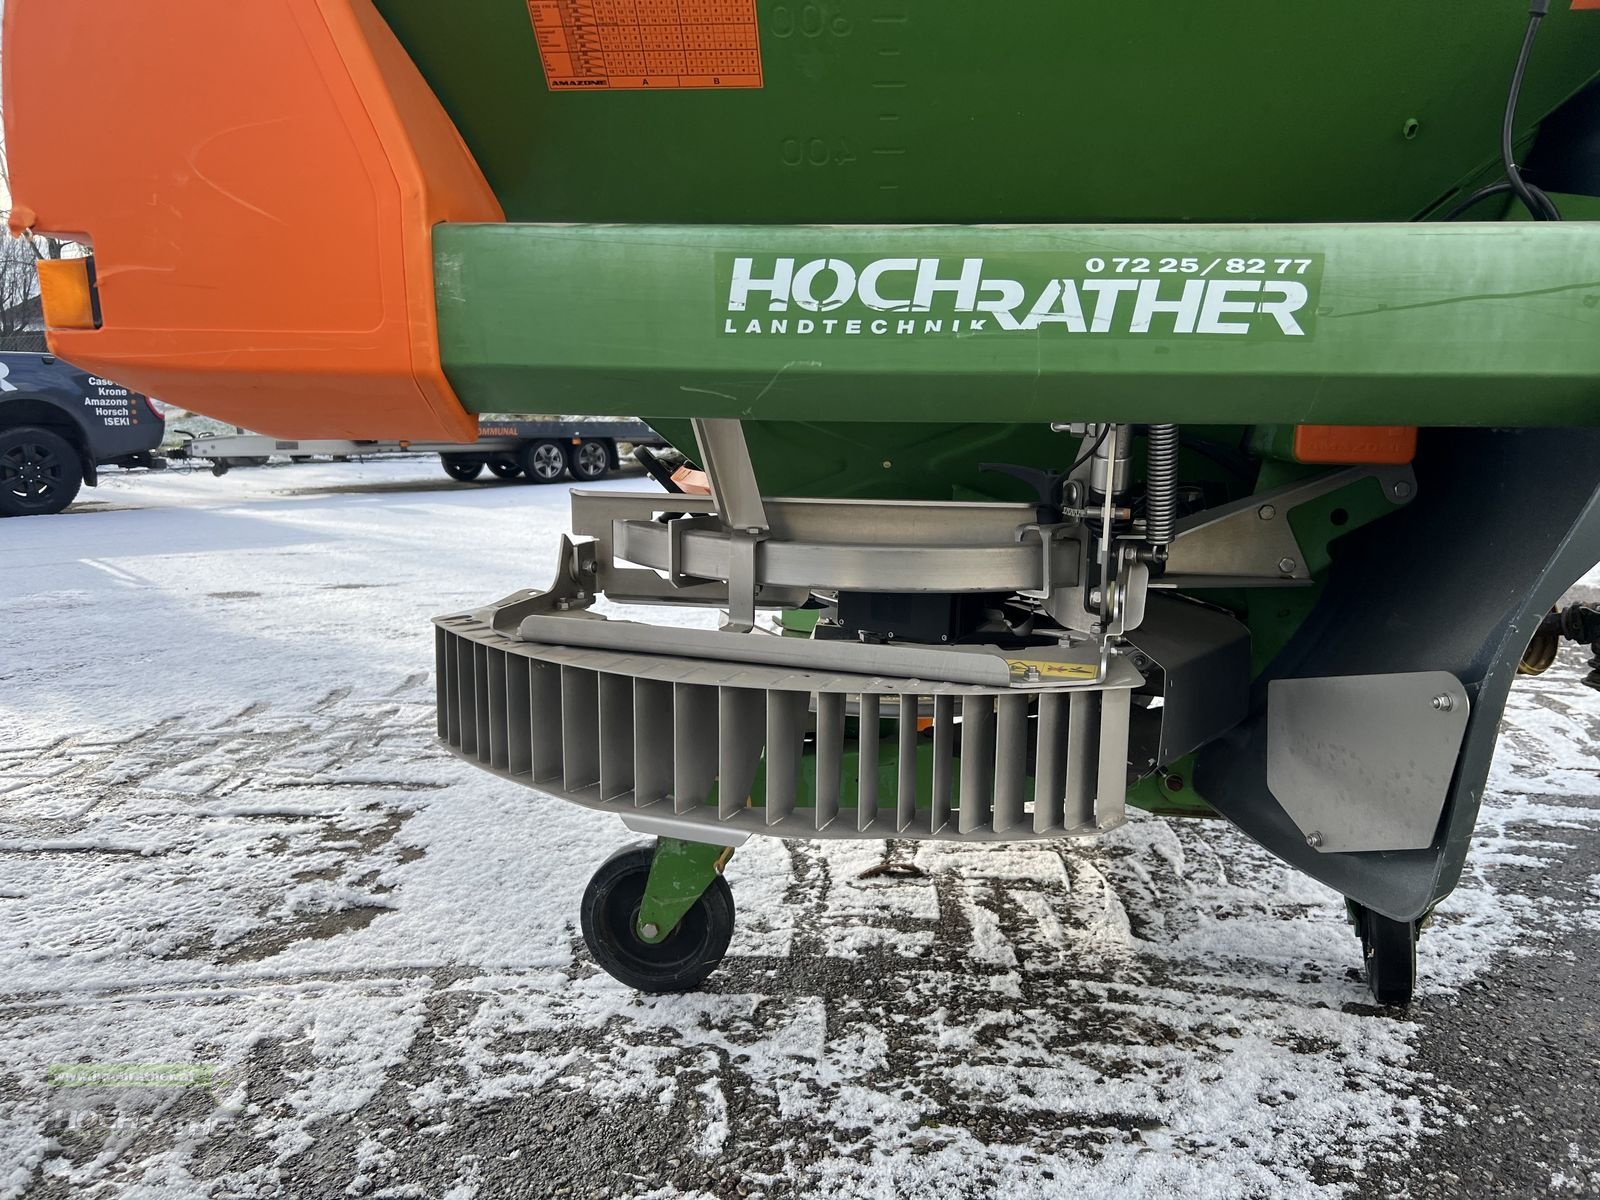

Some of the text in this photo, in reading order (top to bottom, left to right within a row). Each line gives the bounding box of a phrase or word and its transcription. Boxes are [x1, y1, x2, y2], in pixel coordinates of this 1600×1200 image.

[713, 77, 721, 85] B
[1085, 257, 1105, 273] 0
[1112, 257, 1150, 273] 72
[1274, 258, 1312, 274] 77
[724, 319, 988, 335] LANDTECHNIK
[98, 387, 127, 396] Krone
[84, 397, 128, 406] Amazone
[95, 407, 129, 416] Horsch
[104, 417, 130, 426] ISEKI
